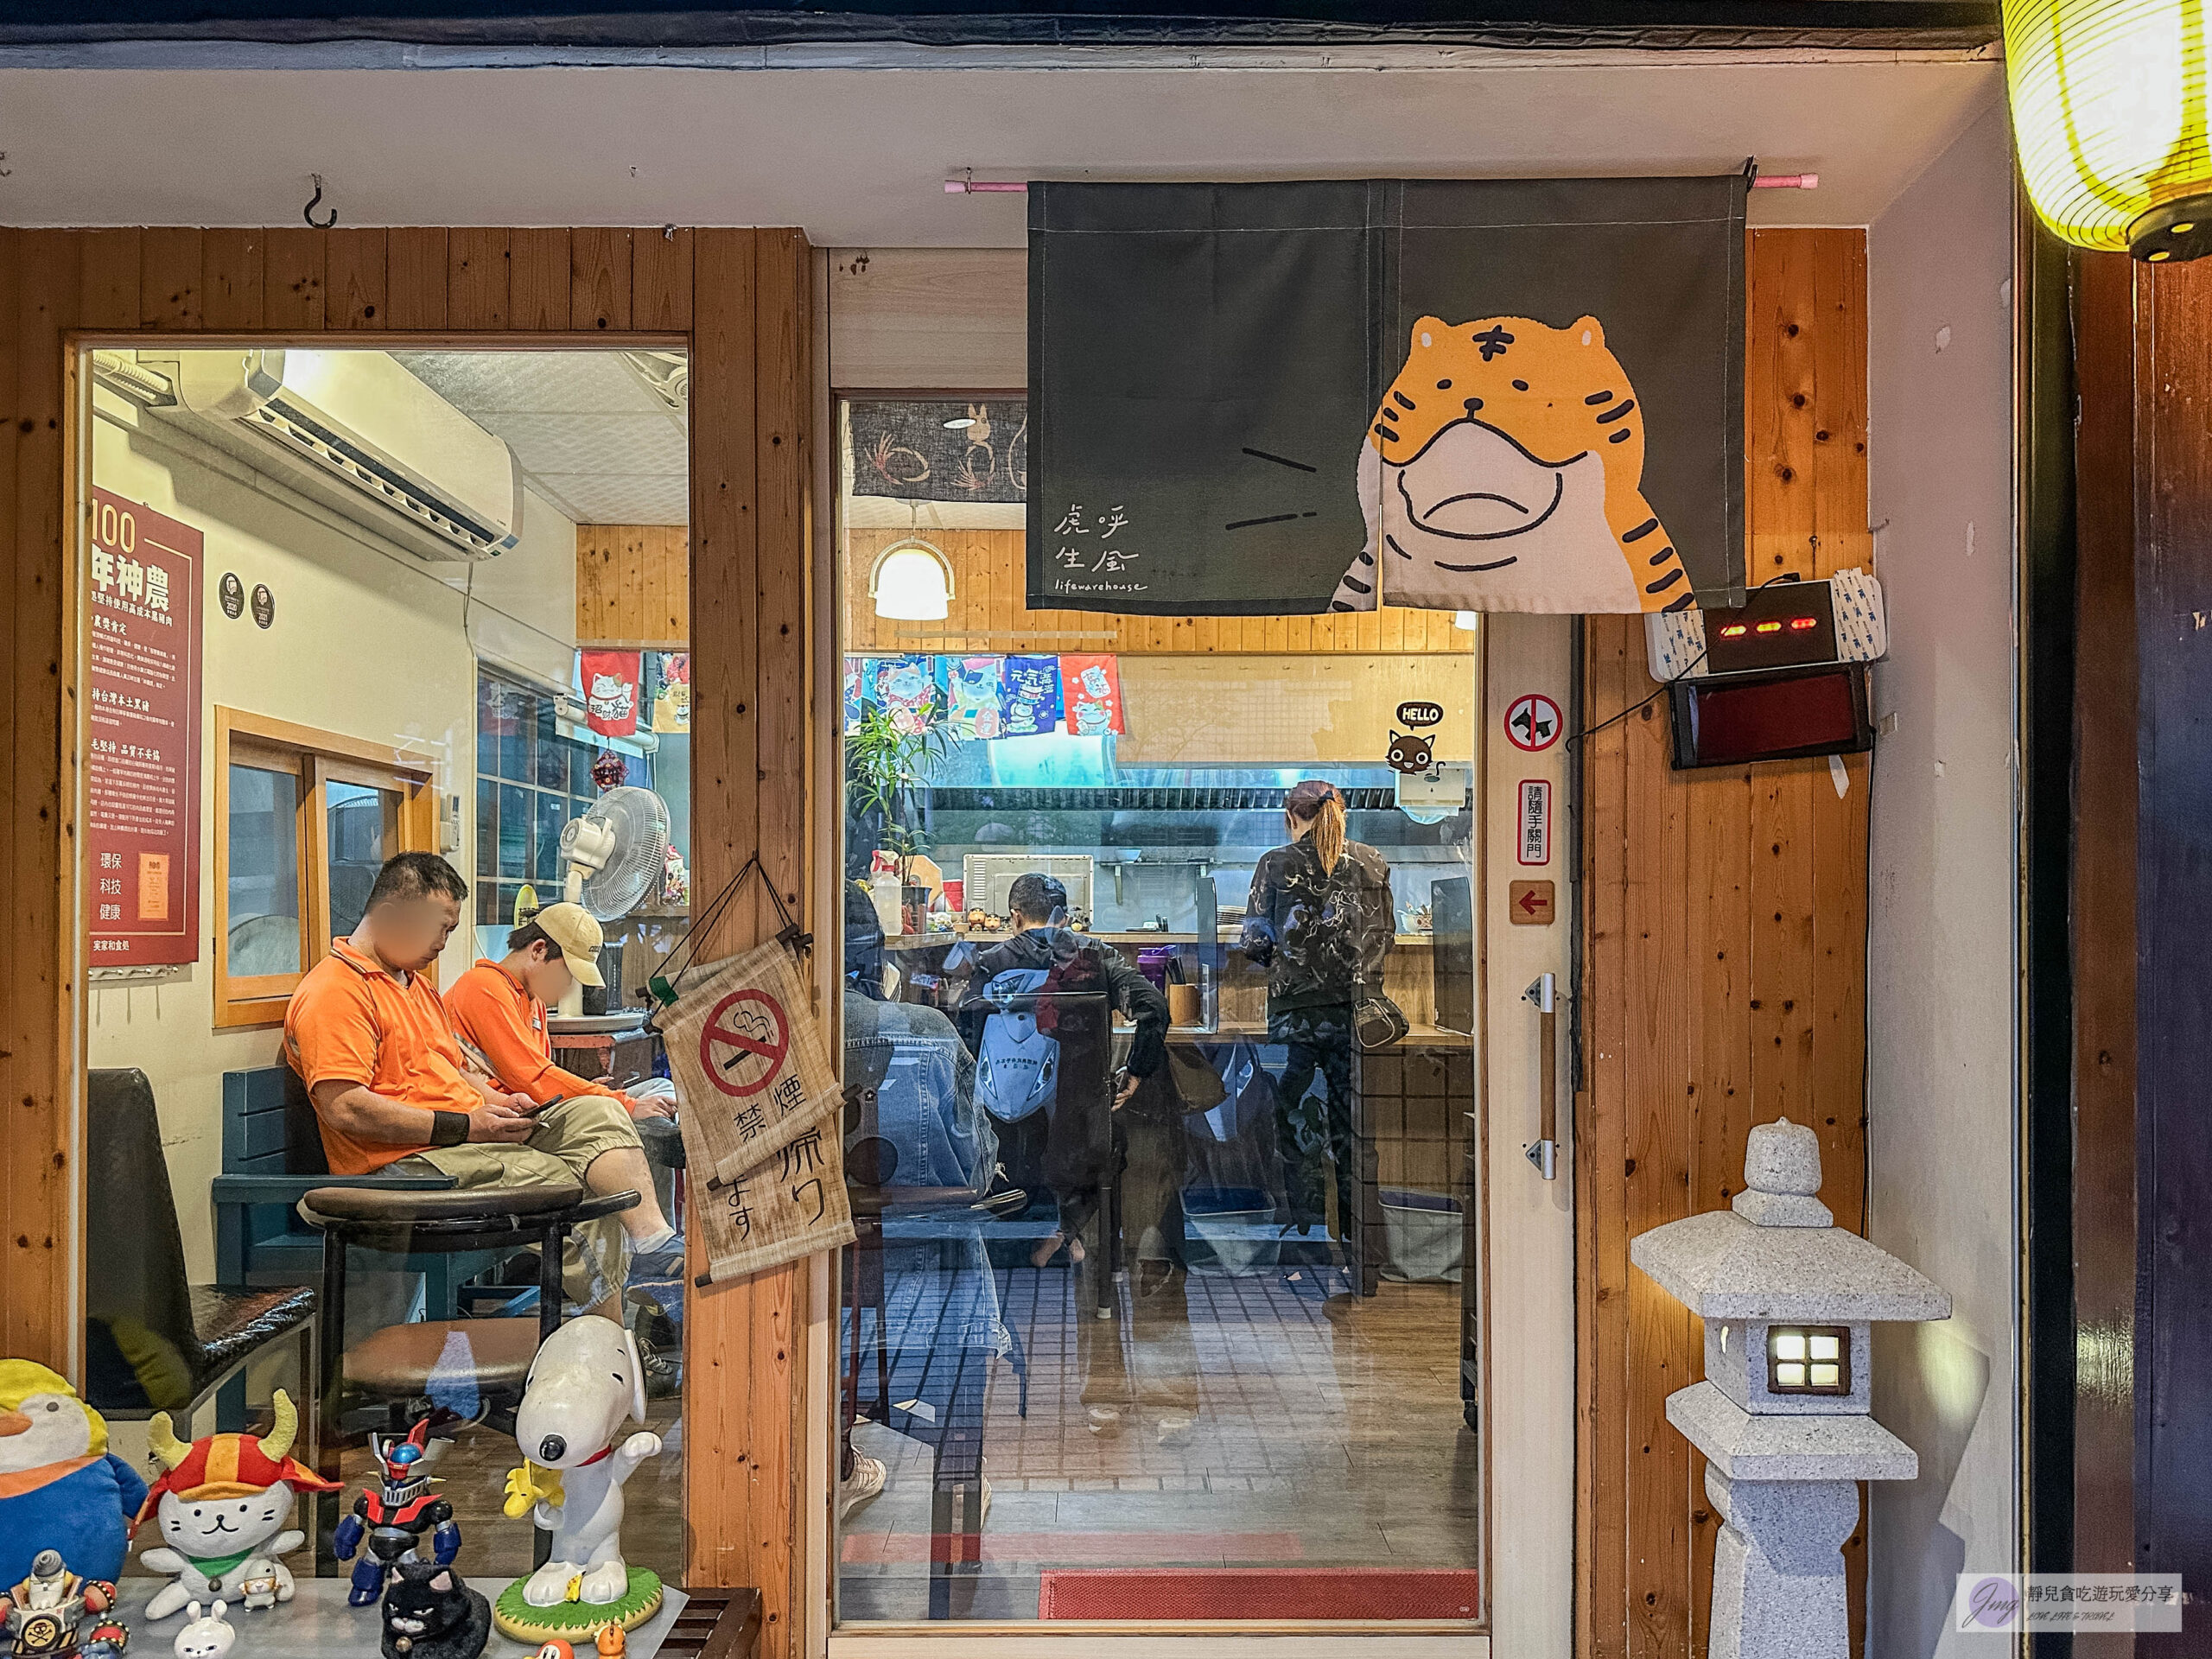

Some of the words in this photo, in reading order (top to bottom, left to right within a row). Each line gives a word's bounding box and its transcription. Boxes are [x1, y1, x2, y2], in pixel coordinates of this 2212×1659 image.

[92, 499, 136, 553] 100
[92, 543, 169, 613] 年神農
[1055, 579, 1148, 594] lifewarehouse
[1402, 708, 1439, 721] HELLO
[1527, 785, 1542, 858] 請隨手關門
[100, 852, 122, 869] 環保
[99, 878, 122, 895] 科技
[99, 904, 121, 920] 健康
[734, 1074, 806, 1142] 禁煙
[724, 1174, 753, 1242] ます
